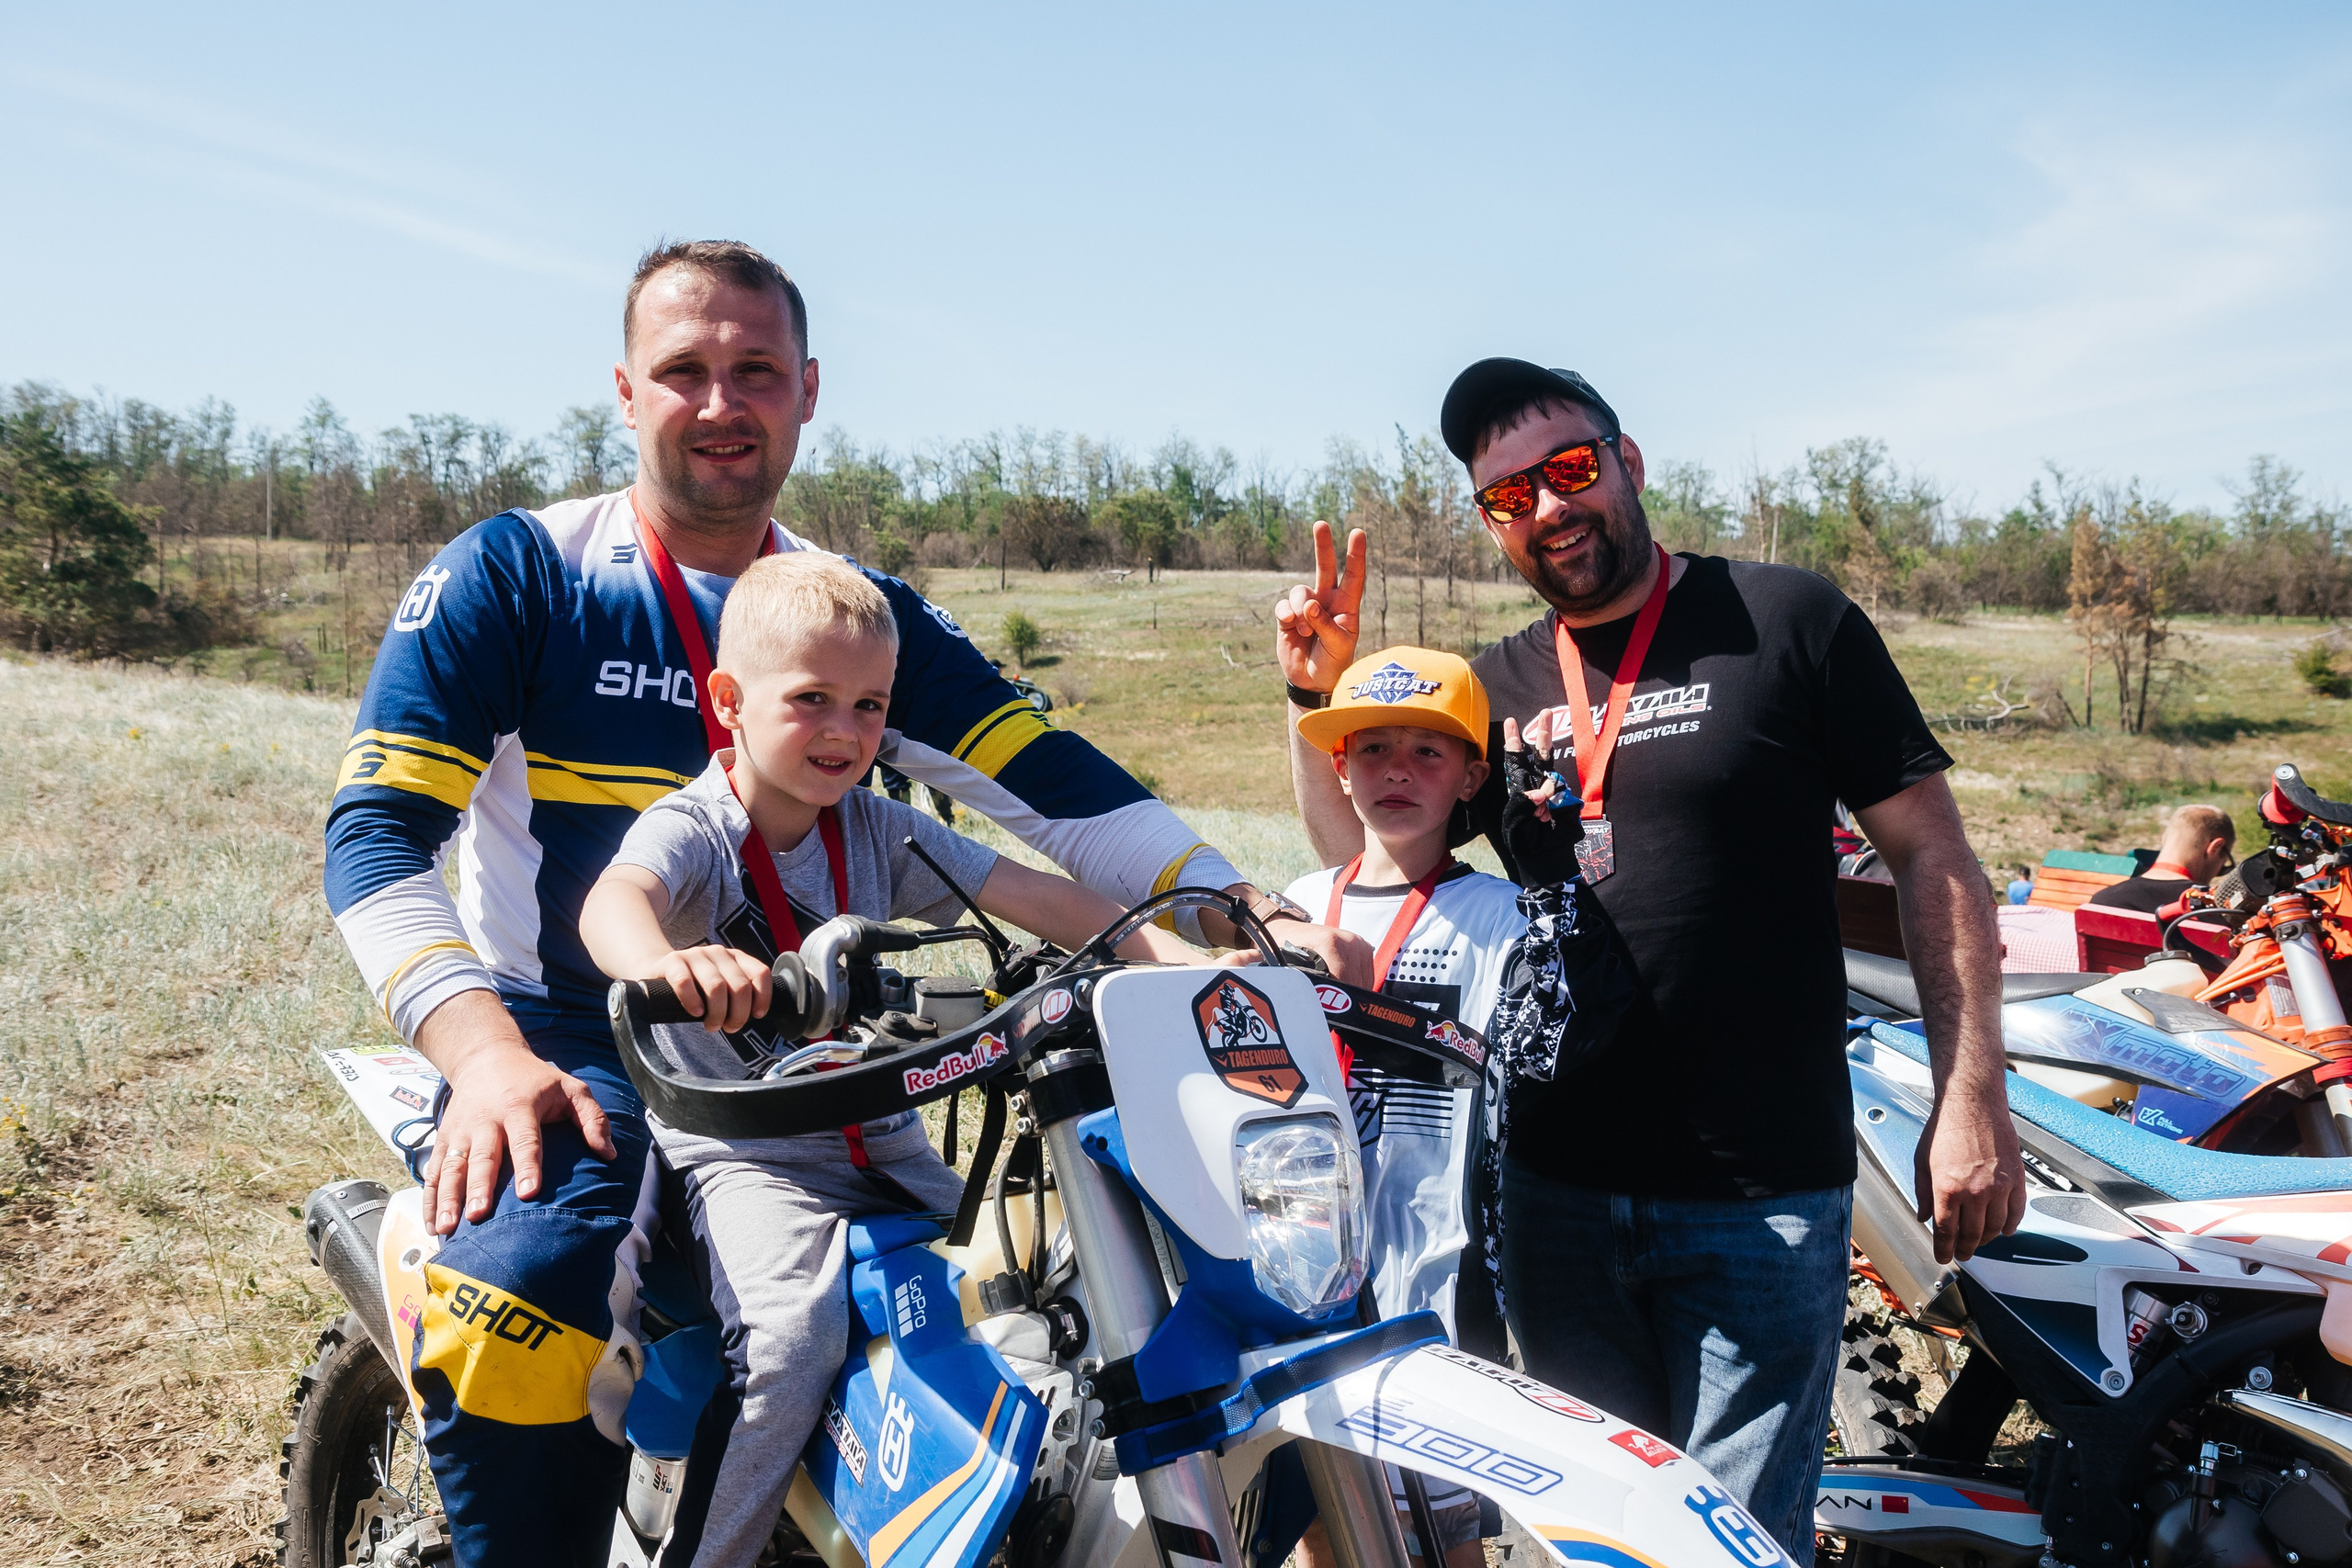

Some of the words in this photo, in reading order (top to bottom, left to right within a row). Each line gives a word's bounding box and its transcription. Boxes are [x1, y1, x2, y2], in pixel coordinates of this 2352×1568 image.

[594, 660, 699, 709] SHO
[1617, 720, 1701, 748] TORCYCLES
[1366, 1002, 1416, 1029] TAGENDURO
[1227, 1048, 1289, 1068] TAGENDURO
[448, 1282, 565, 1351] SHOT
